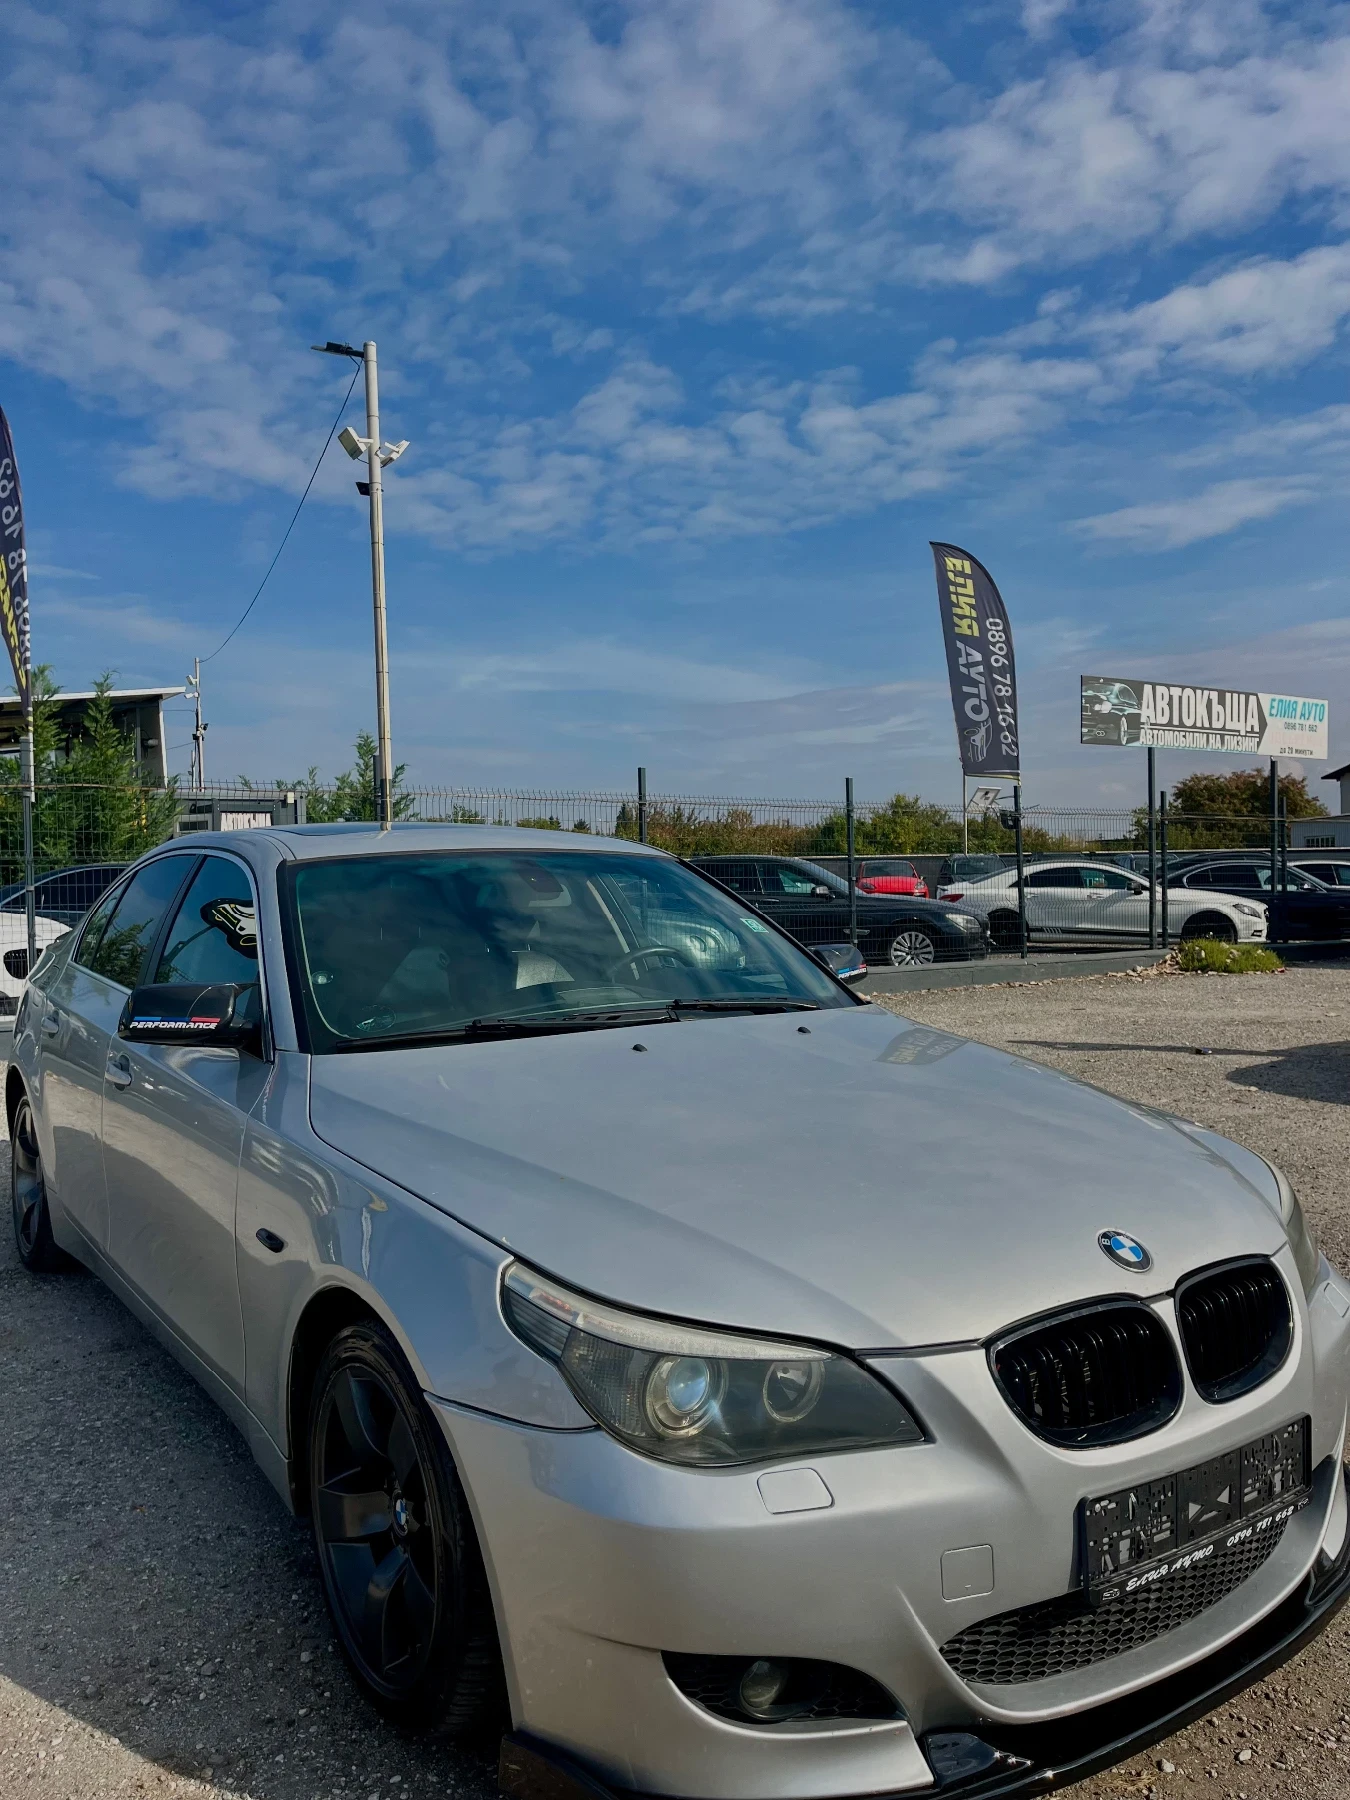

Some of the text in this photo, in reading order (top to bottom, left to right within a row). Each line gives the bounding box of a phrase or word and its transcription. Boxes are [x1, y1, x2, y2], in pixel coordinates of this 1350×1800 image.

[945, 556, 990, 722] ЕЛИЯ АУТО
[985, 617, 1018, 757] 0896 78 16 62
[1140, 683, 1260, 736] АВТОКЪЩА
[1269, 698, 1325, 723] ЕЛИЯ АУТО
[1139, 730, 1207, 749] АВТОМОБИЛИ
[1209, 734, 1222, 750] НА
[1222, 735, 1259, 754] ЛИЗИНГ
[130, 1021, 219, 1030] PERFORMANCE
[1226, 1505, 1295, 1547] 0896 781 662
